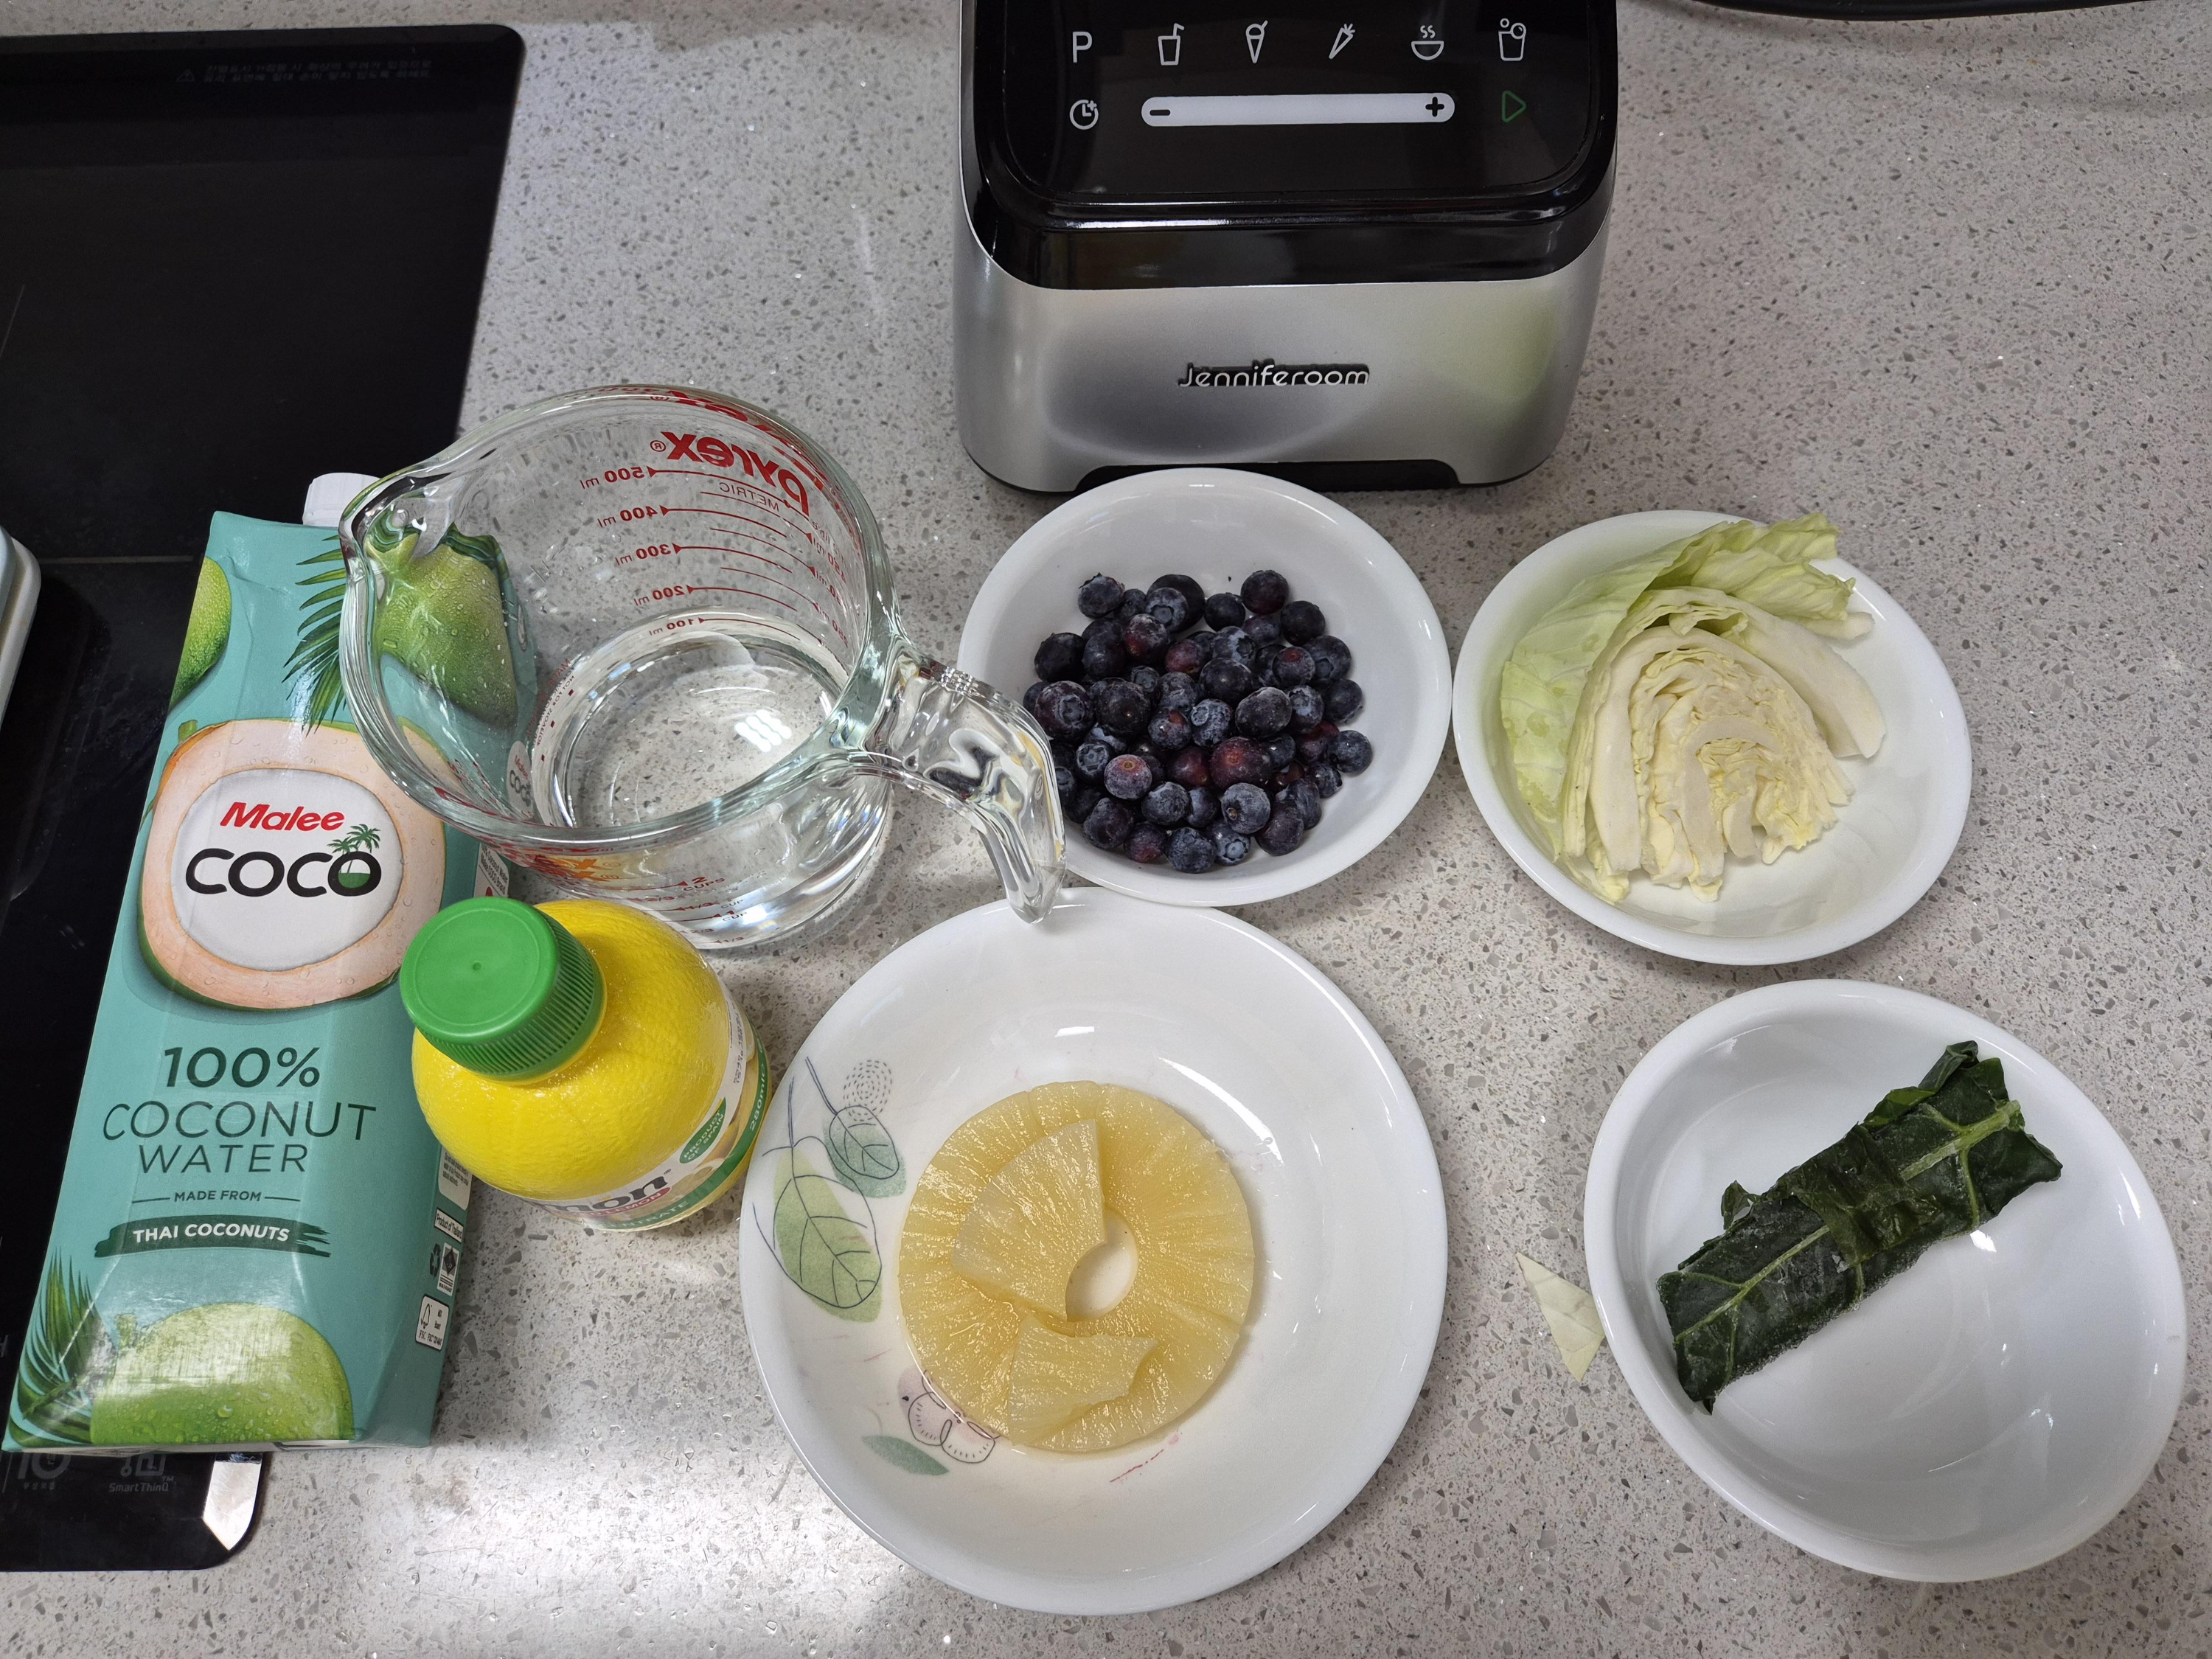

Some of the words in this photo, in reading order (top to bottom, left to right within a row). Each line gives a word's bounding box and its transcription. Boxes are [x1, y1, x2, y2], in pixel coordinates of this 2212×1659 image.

[1072, 31, 1093, 64] P
[1179, 364, 1369, 387] Jenniferoom
[220, 801, 345, 832] Malee
[185, 848, 382, 897] COCO
[683, 877, 726, 891] CUPS
[164, 1046, 321, 1088] 100%
[102, 1100, 377, 1140] COCONUT
[684, 1110, 720, 1158] PRODUCT
[688, 1147, 700, 1161] OF
[703, 1113, 724, 1144] SPAIN
[139, 1144, 308, 1174] WATER
[174, 1190, 217, 1203] MADE
[220, 1190, 262, 1202] FROM
[605, 1192, 662, 1215] LEMON
[133, 1225, 179, 1243] THAI
[184, 1223, 291, 1242] COCONUTS
